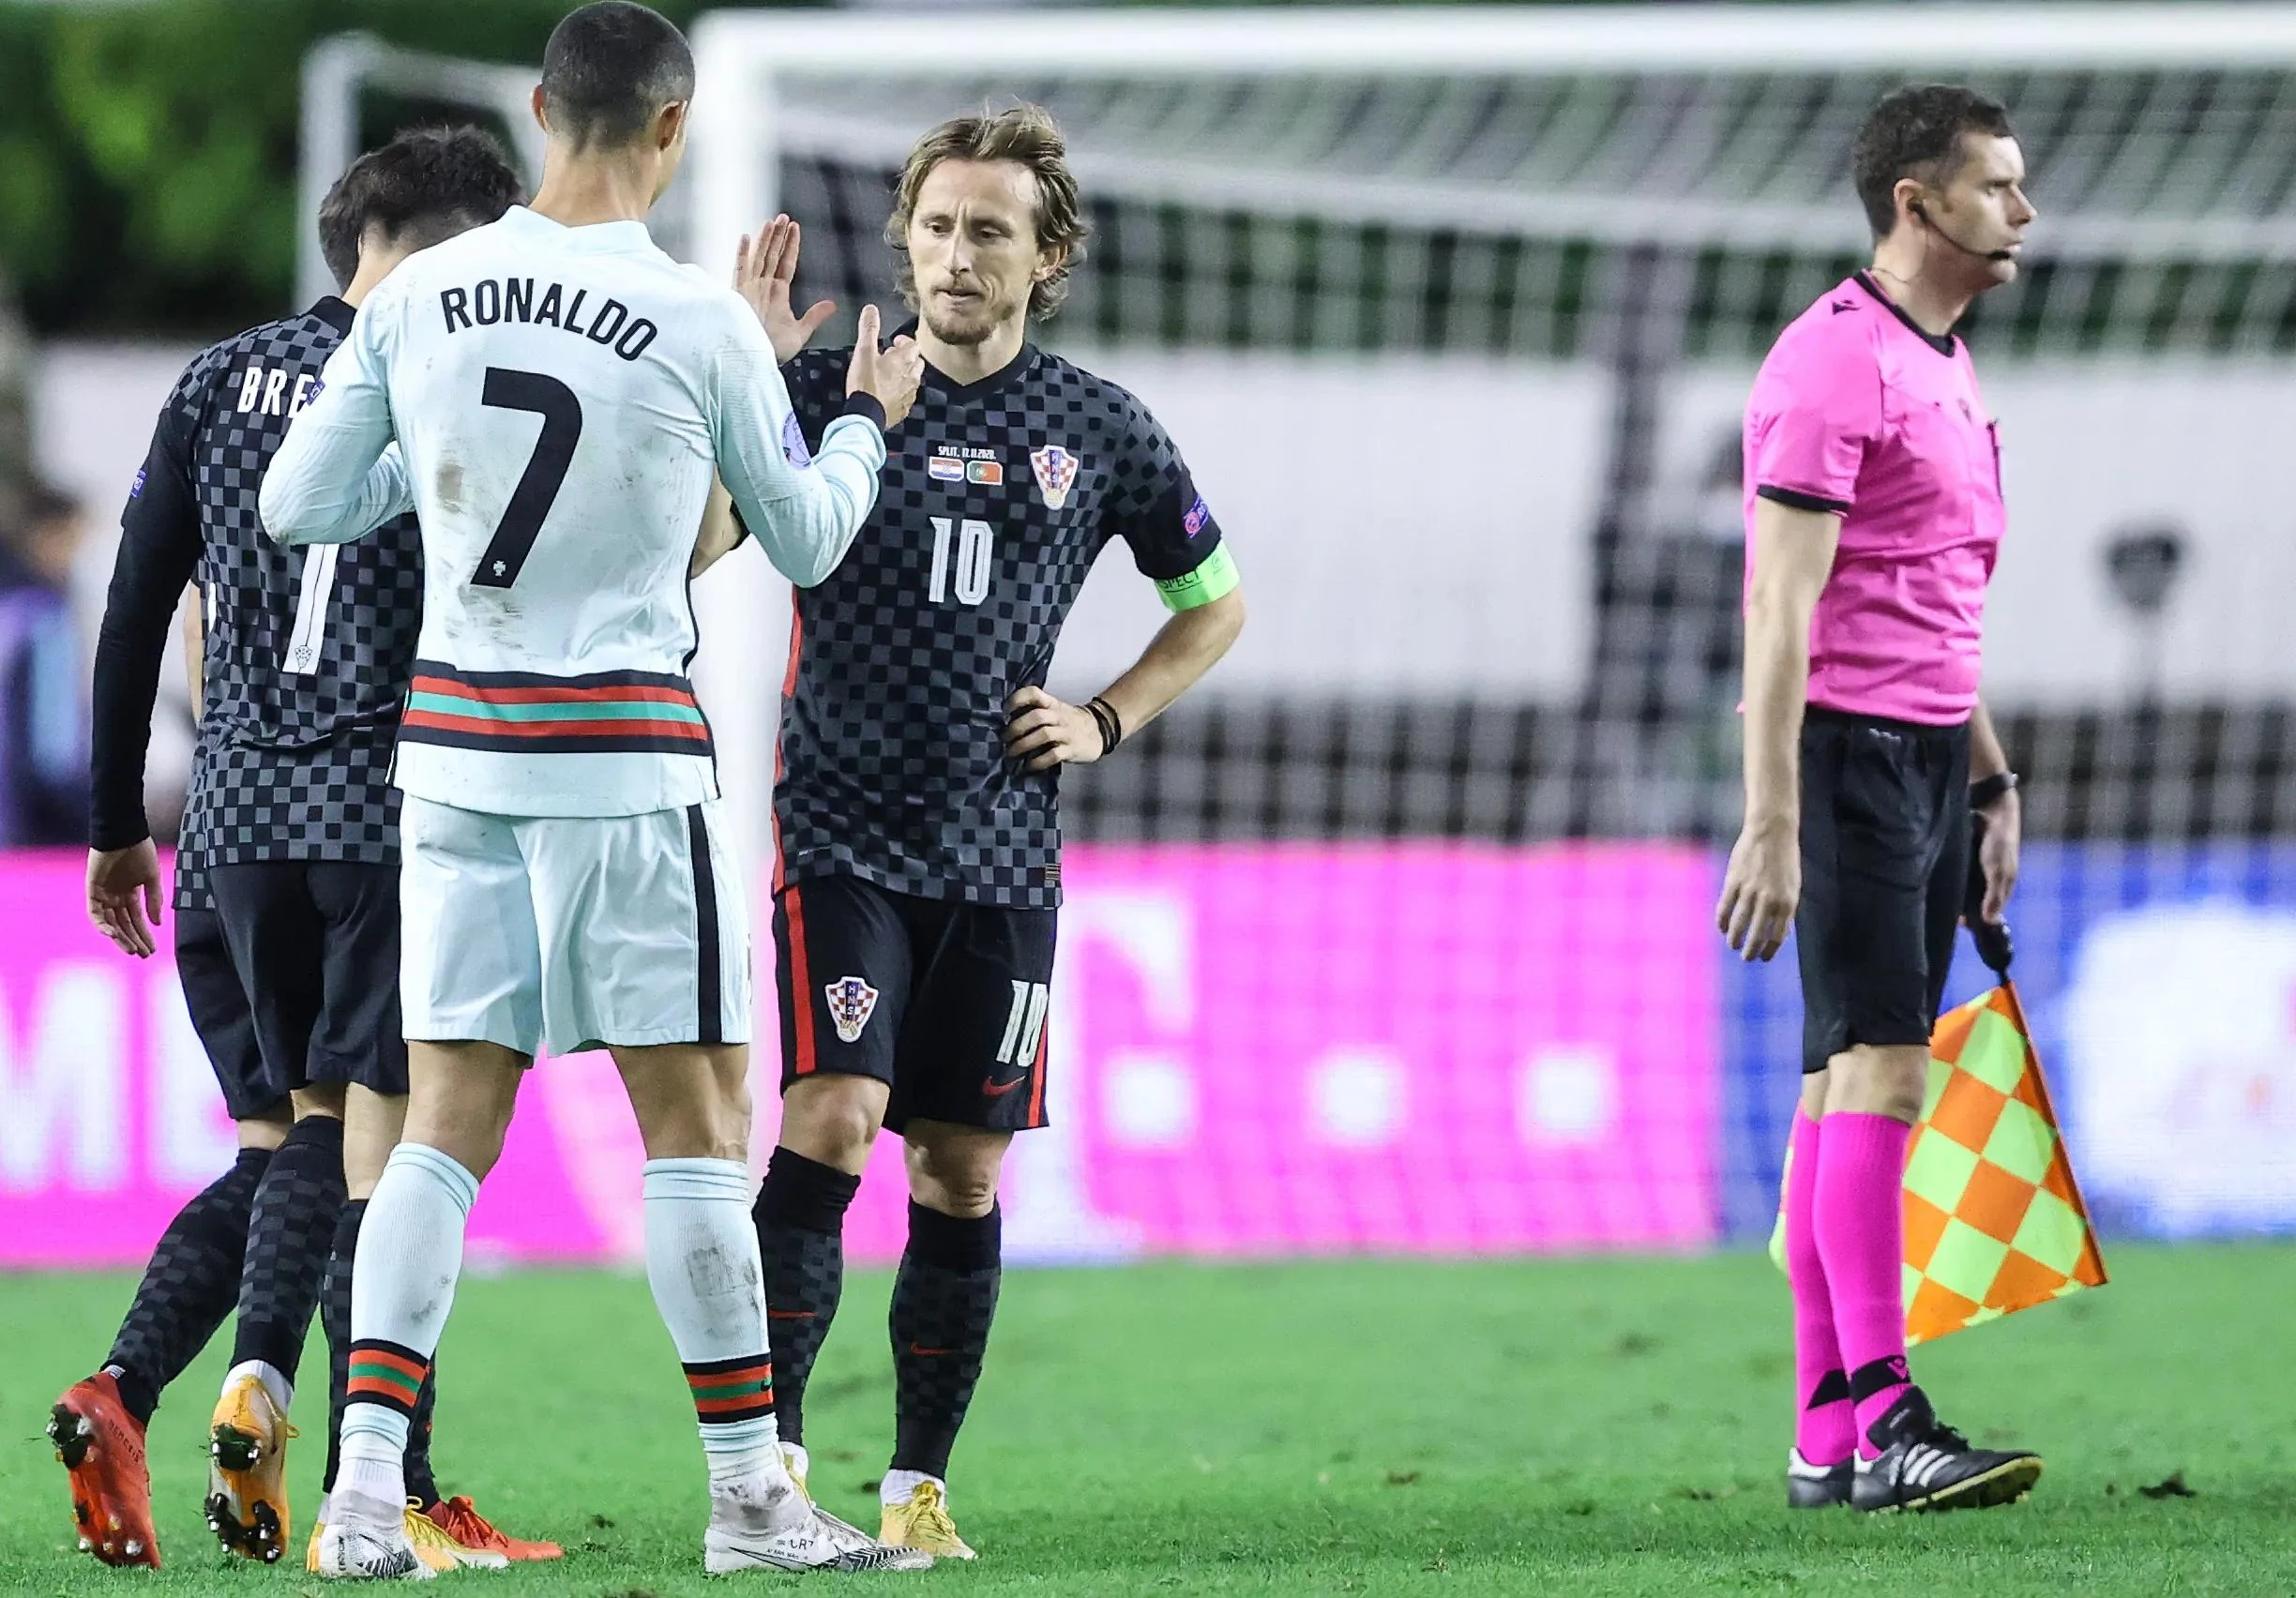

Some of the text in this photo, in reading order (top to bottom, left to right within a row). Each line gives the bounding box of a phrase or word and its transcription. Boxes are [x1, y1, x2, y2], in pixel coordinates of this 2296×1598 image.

[441, 278, 657, 361] RONALDO
[470, 367, 582, 589] 7
[929, 516, 994, 606] 10
[996, 979, 1049, 1067] 10
